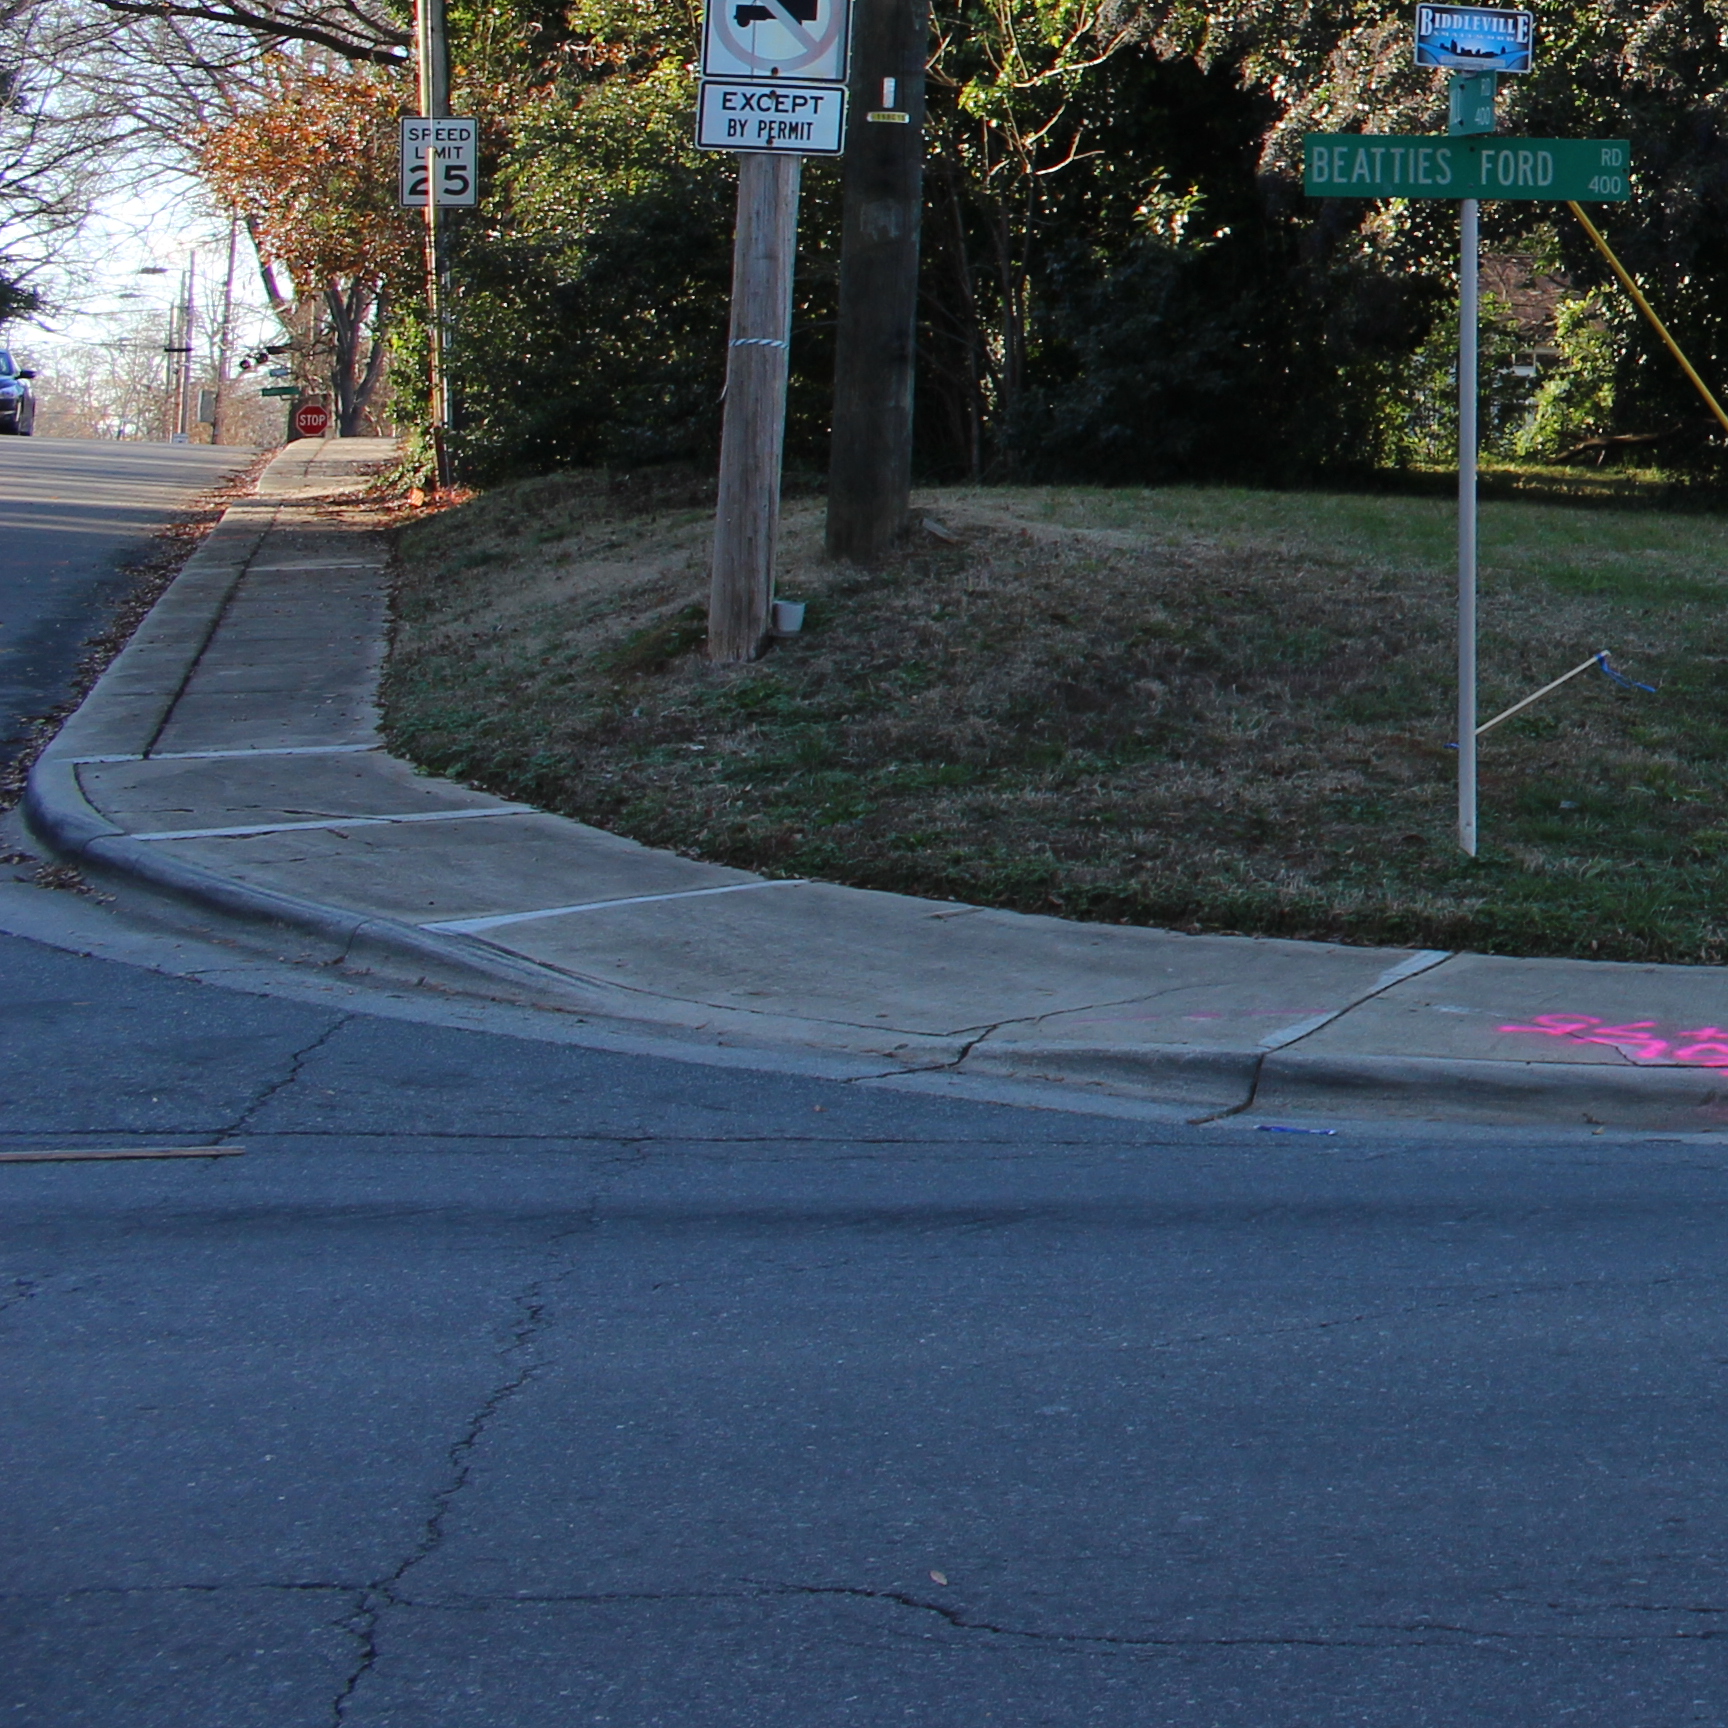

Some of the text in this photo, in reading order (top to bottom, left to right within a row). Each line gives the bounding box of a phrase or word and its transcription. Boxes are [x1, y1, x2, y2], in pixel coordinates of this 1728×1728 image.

[1420, 8, 1529, 43] BIDDLEVILLE
[722, 92, 824, 114] EXCEPT
[408, 128, 471, 141] SPEED
[727, 118, 814, 141] BY PERMIT
[415, 146, 463, 159] LMIT
[1312, 146, 1622, 186] BEATTIES FORD RD
[408, 165, 470, 196] 25
[1588, 175, 1621, 194] 400
[300, 414, 326, 426] STOP
